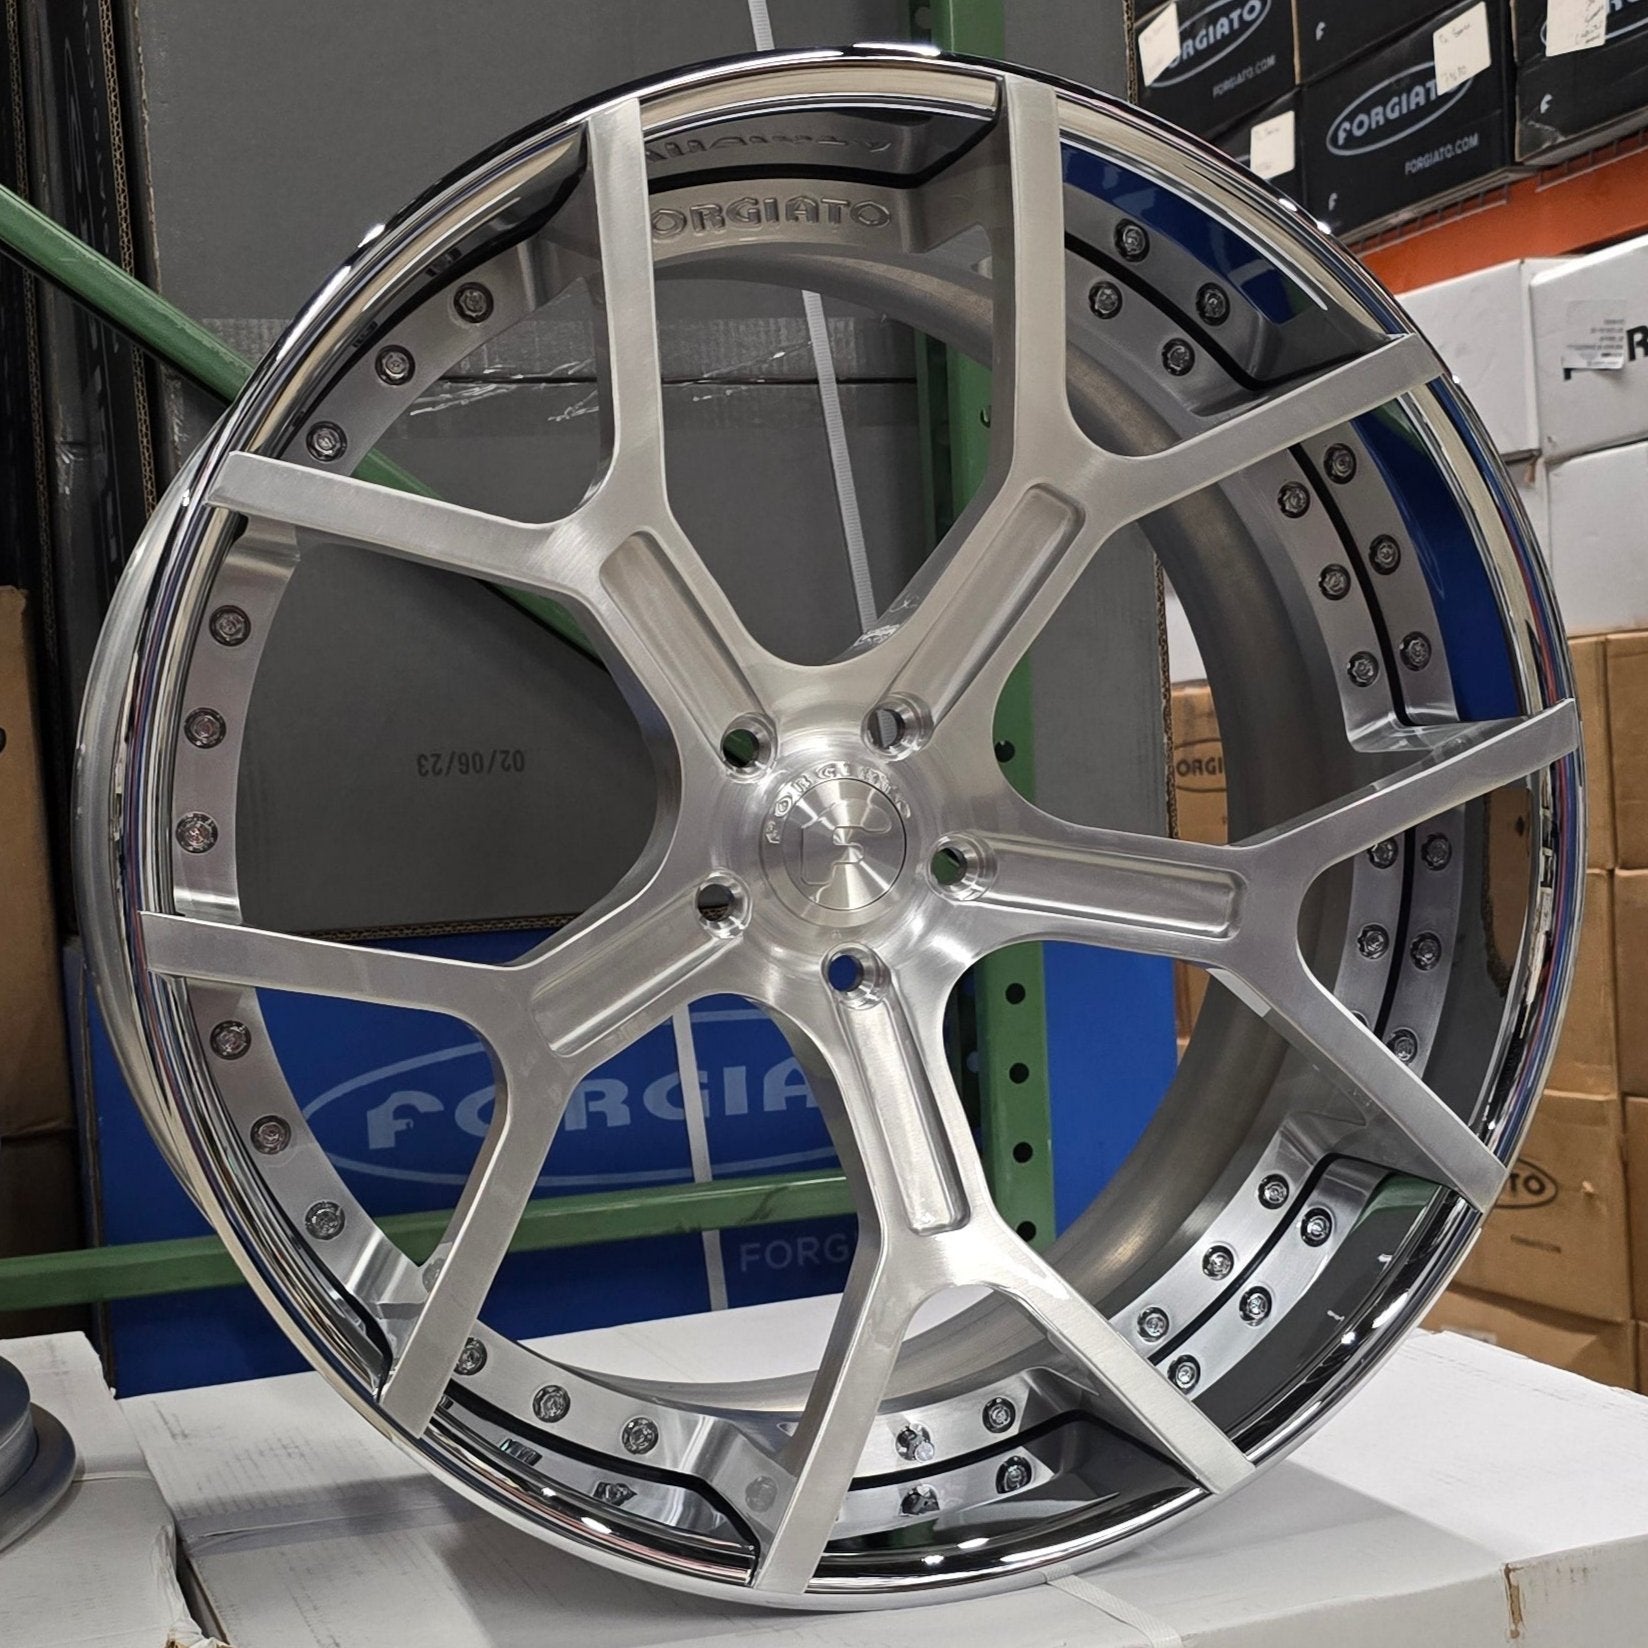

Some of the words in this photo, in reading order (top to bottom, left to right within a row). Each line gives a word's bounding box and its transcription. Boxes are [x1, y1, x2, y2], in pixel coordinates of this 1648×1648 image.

[1168, 0, 1262, 68] RGIATO
[1337, 79, 1440, 146] FORGIAT
[1405, 132, 1480, 175] FORGIATO.COM
[416, 750, 525, 777] 02/06/23
